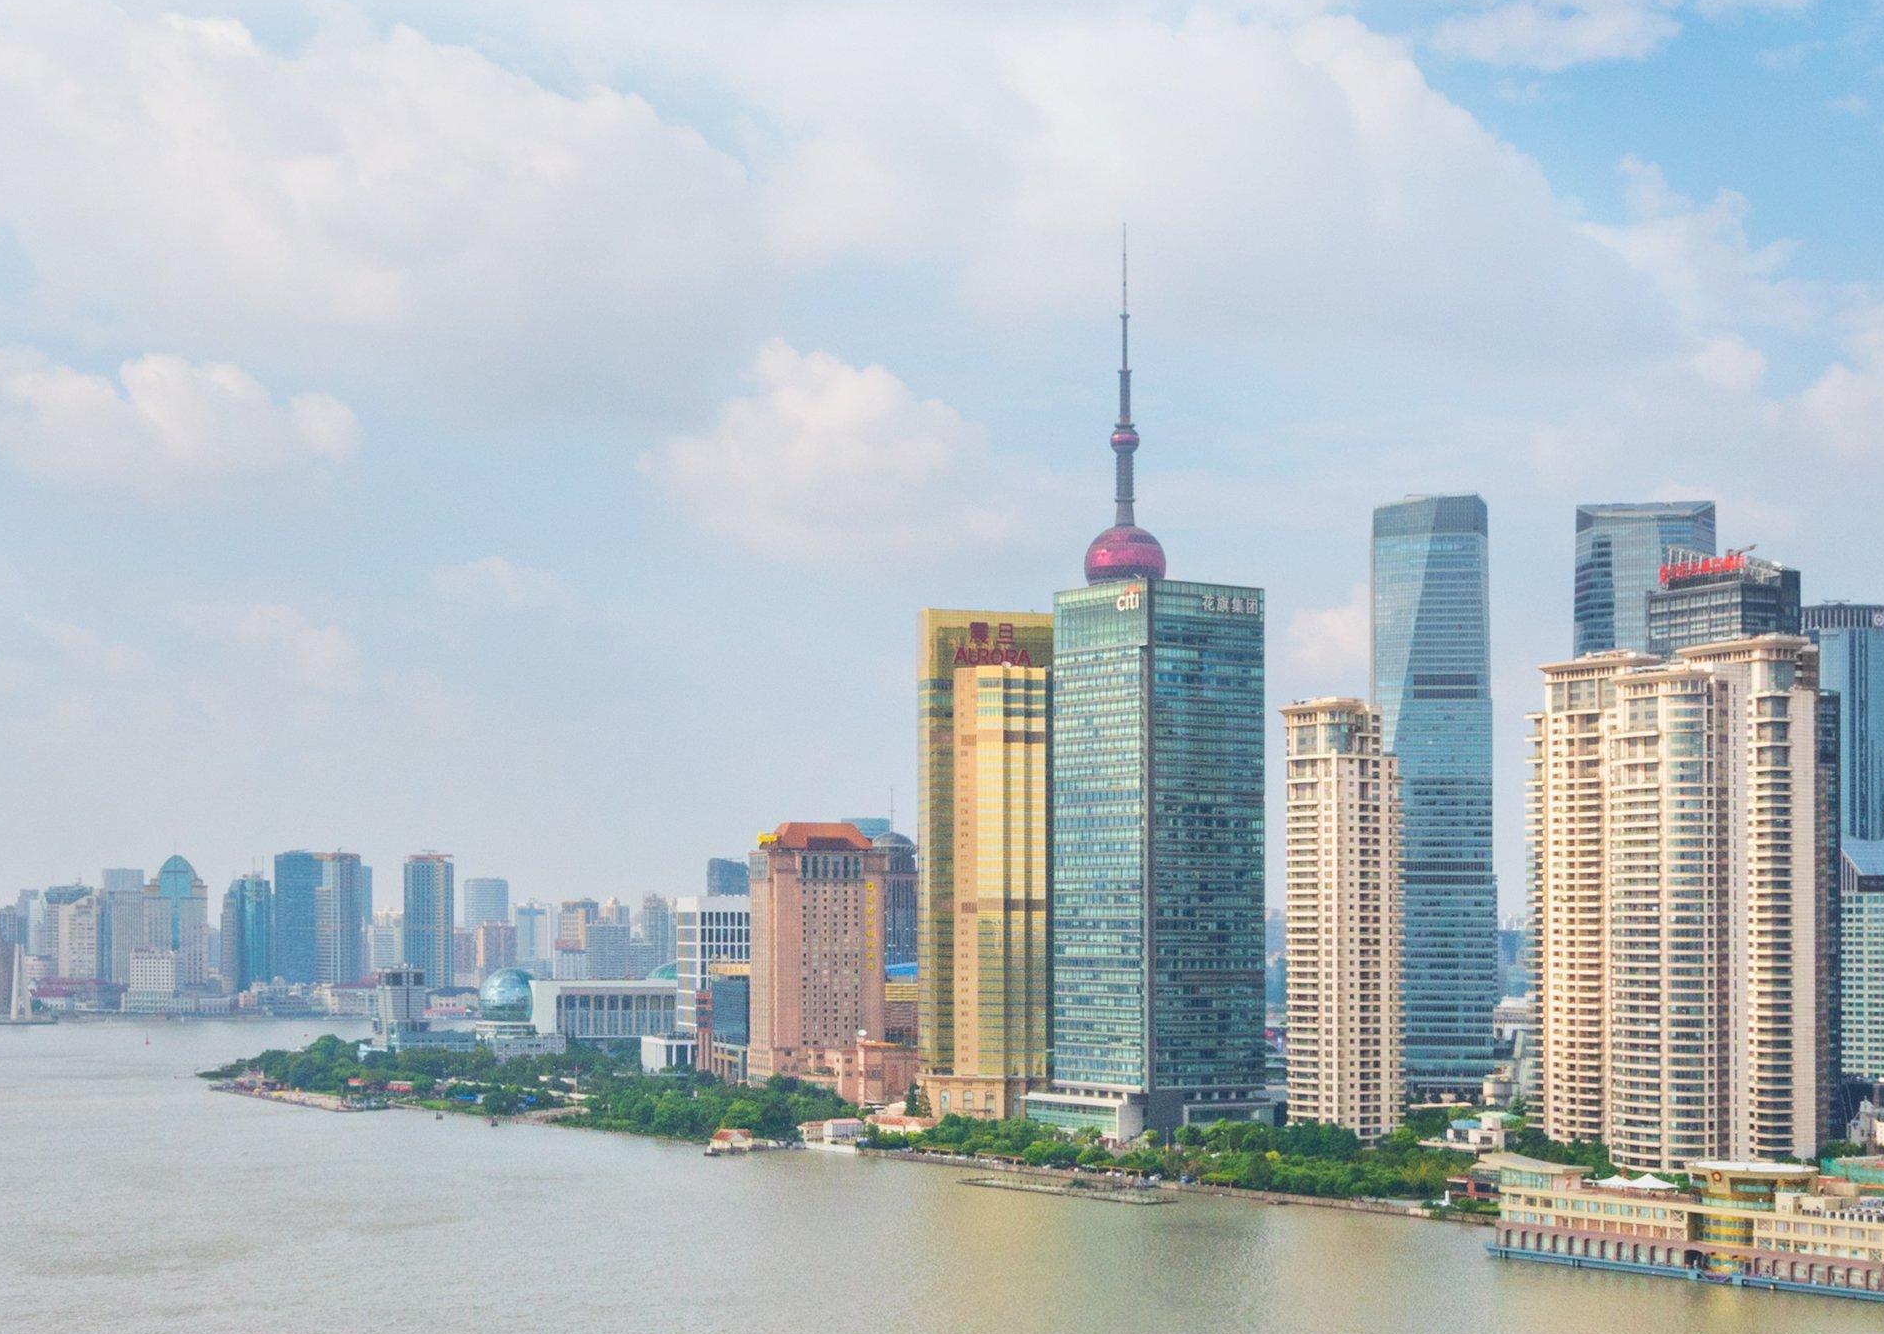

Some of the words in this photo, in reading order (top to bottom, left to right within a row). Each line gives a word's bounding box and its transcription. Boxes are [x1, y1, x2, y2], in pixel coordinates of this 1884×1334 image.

[1116, 591, 1140, 611] citi
[1202, 594, 1259, 614] 花旗集团
[952, 646, 1031, 667] AURORA
